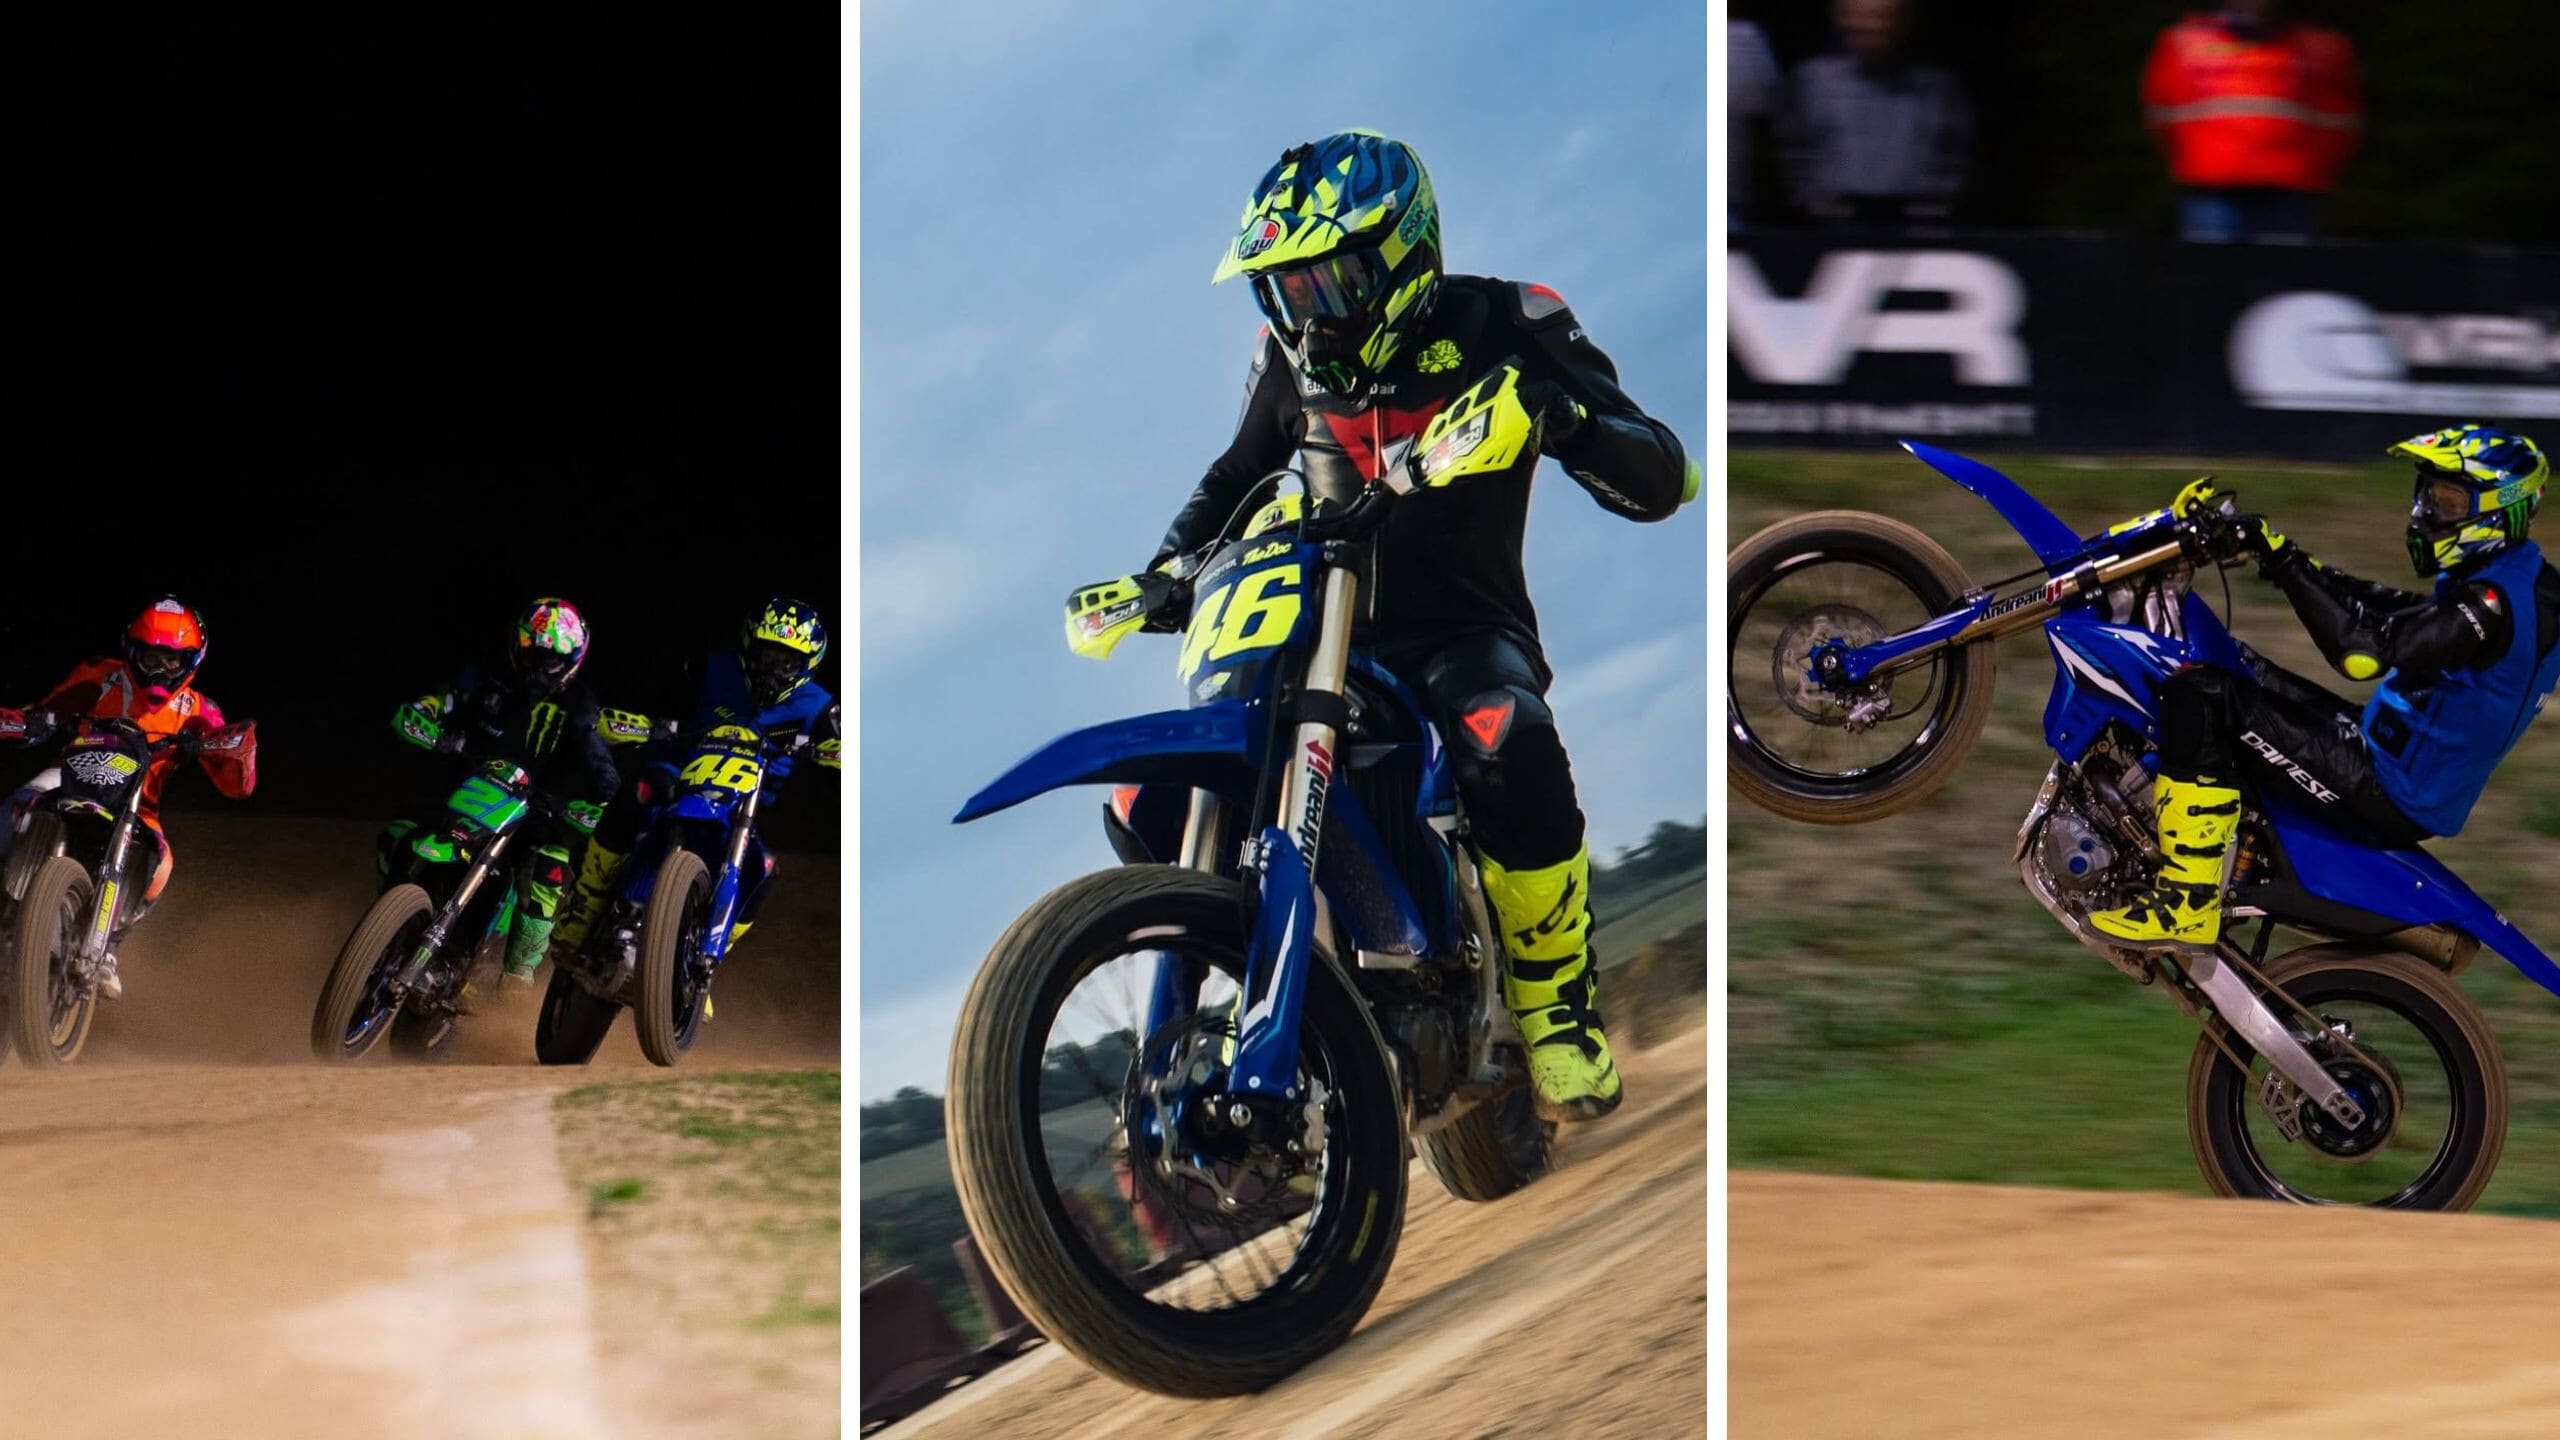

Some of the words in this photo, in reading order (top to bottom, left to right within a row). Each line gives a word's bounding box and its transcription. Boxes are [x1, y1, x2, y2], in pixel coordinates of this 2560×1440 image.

[1177, 563, 1301, 686] 46
[1980, 583, 2047, 622] Andreani
[679, 753, 759, 794] 46
[2239, 730, 2341, 805] DAINESE
[449, 775, 528, 833] 21
